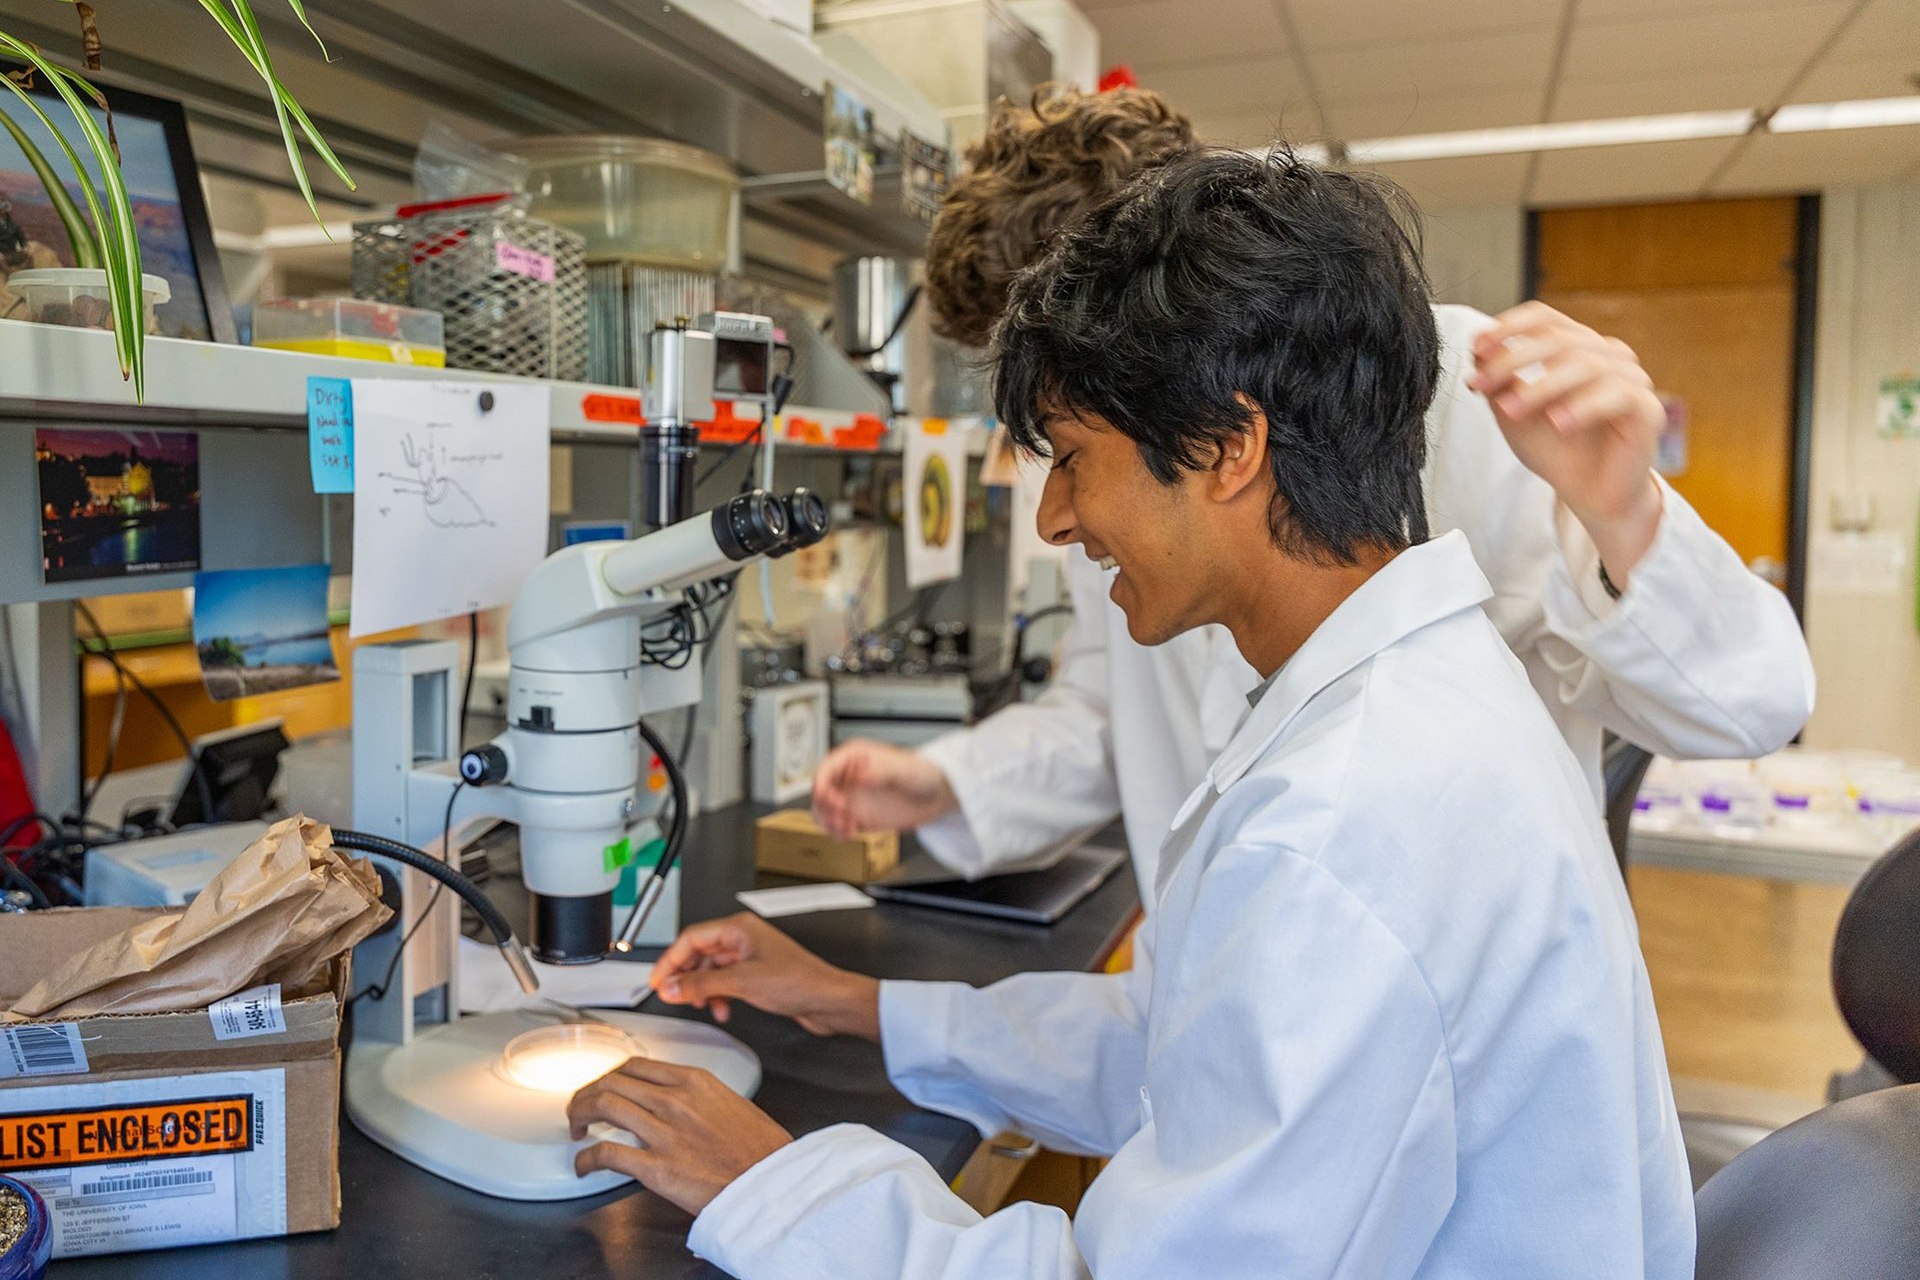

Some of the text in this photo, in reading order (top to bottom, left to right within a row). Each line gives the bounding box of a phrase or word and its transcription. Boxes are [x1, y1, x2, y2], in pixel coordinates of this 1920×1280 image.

[0, 1107, 243, 1160] LIST ENCLOSED
[77, 1206, 116, 1216] UNIVERSITY
